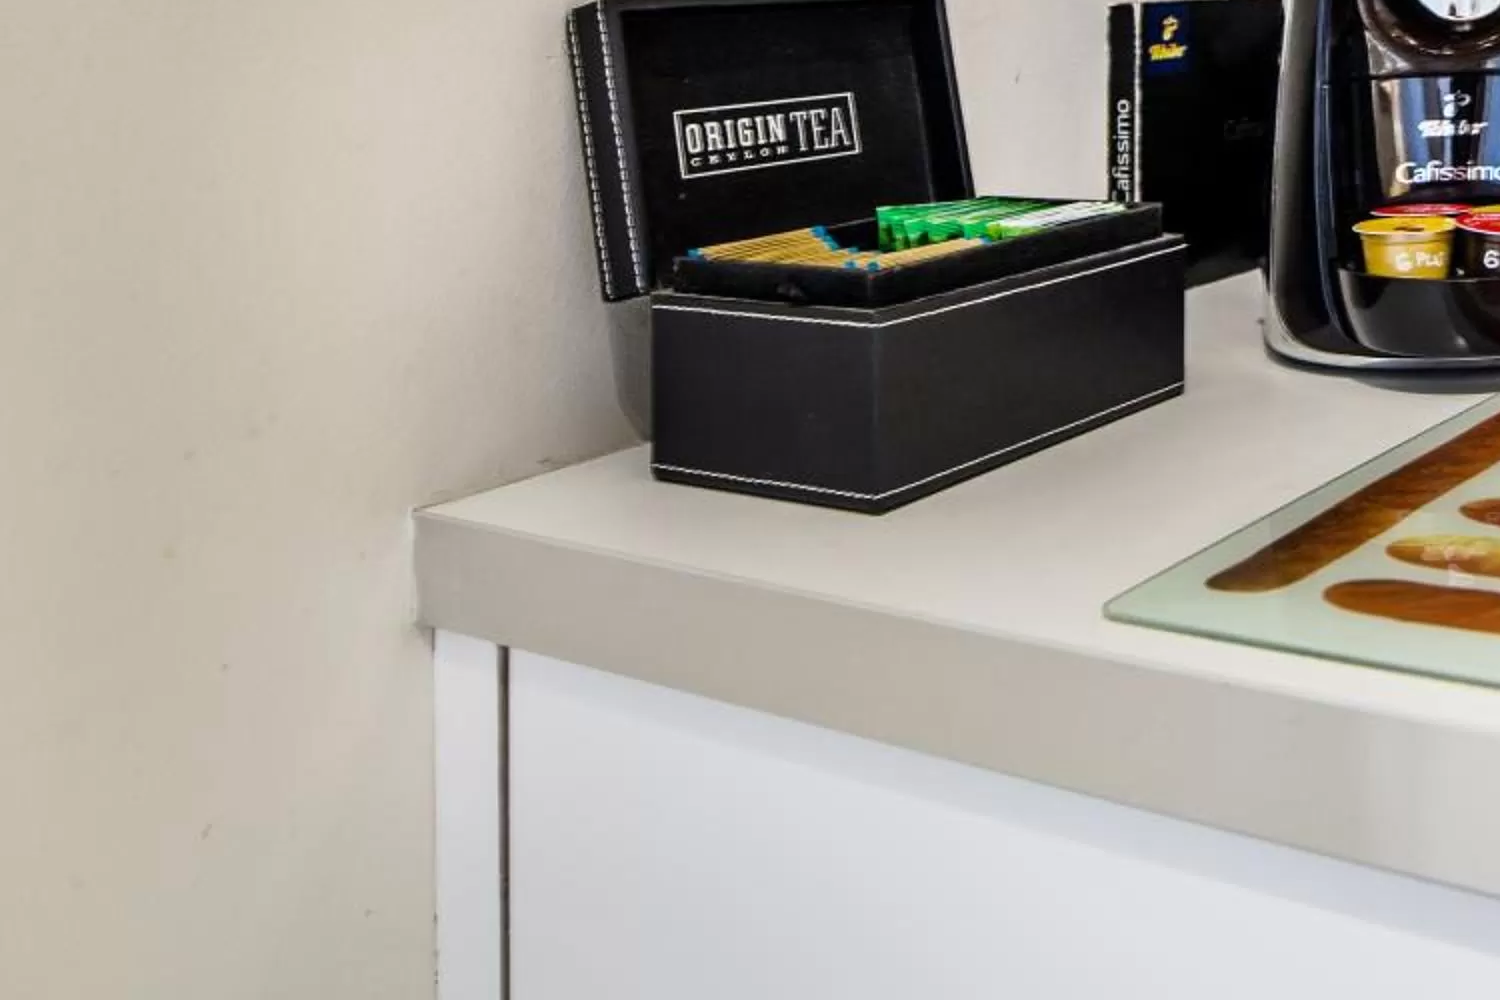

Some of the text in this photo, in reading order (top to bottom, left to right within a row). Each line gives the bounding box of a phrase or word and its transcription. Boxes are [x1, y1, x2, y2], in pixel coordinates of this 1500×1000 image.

[685, 107, 852, 154] ORIGIN TEA
[689, 145, 790, 168] CEYLON
